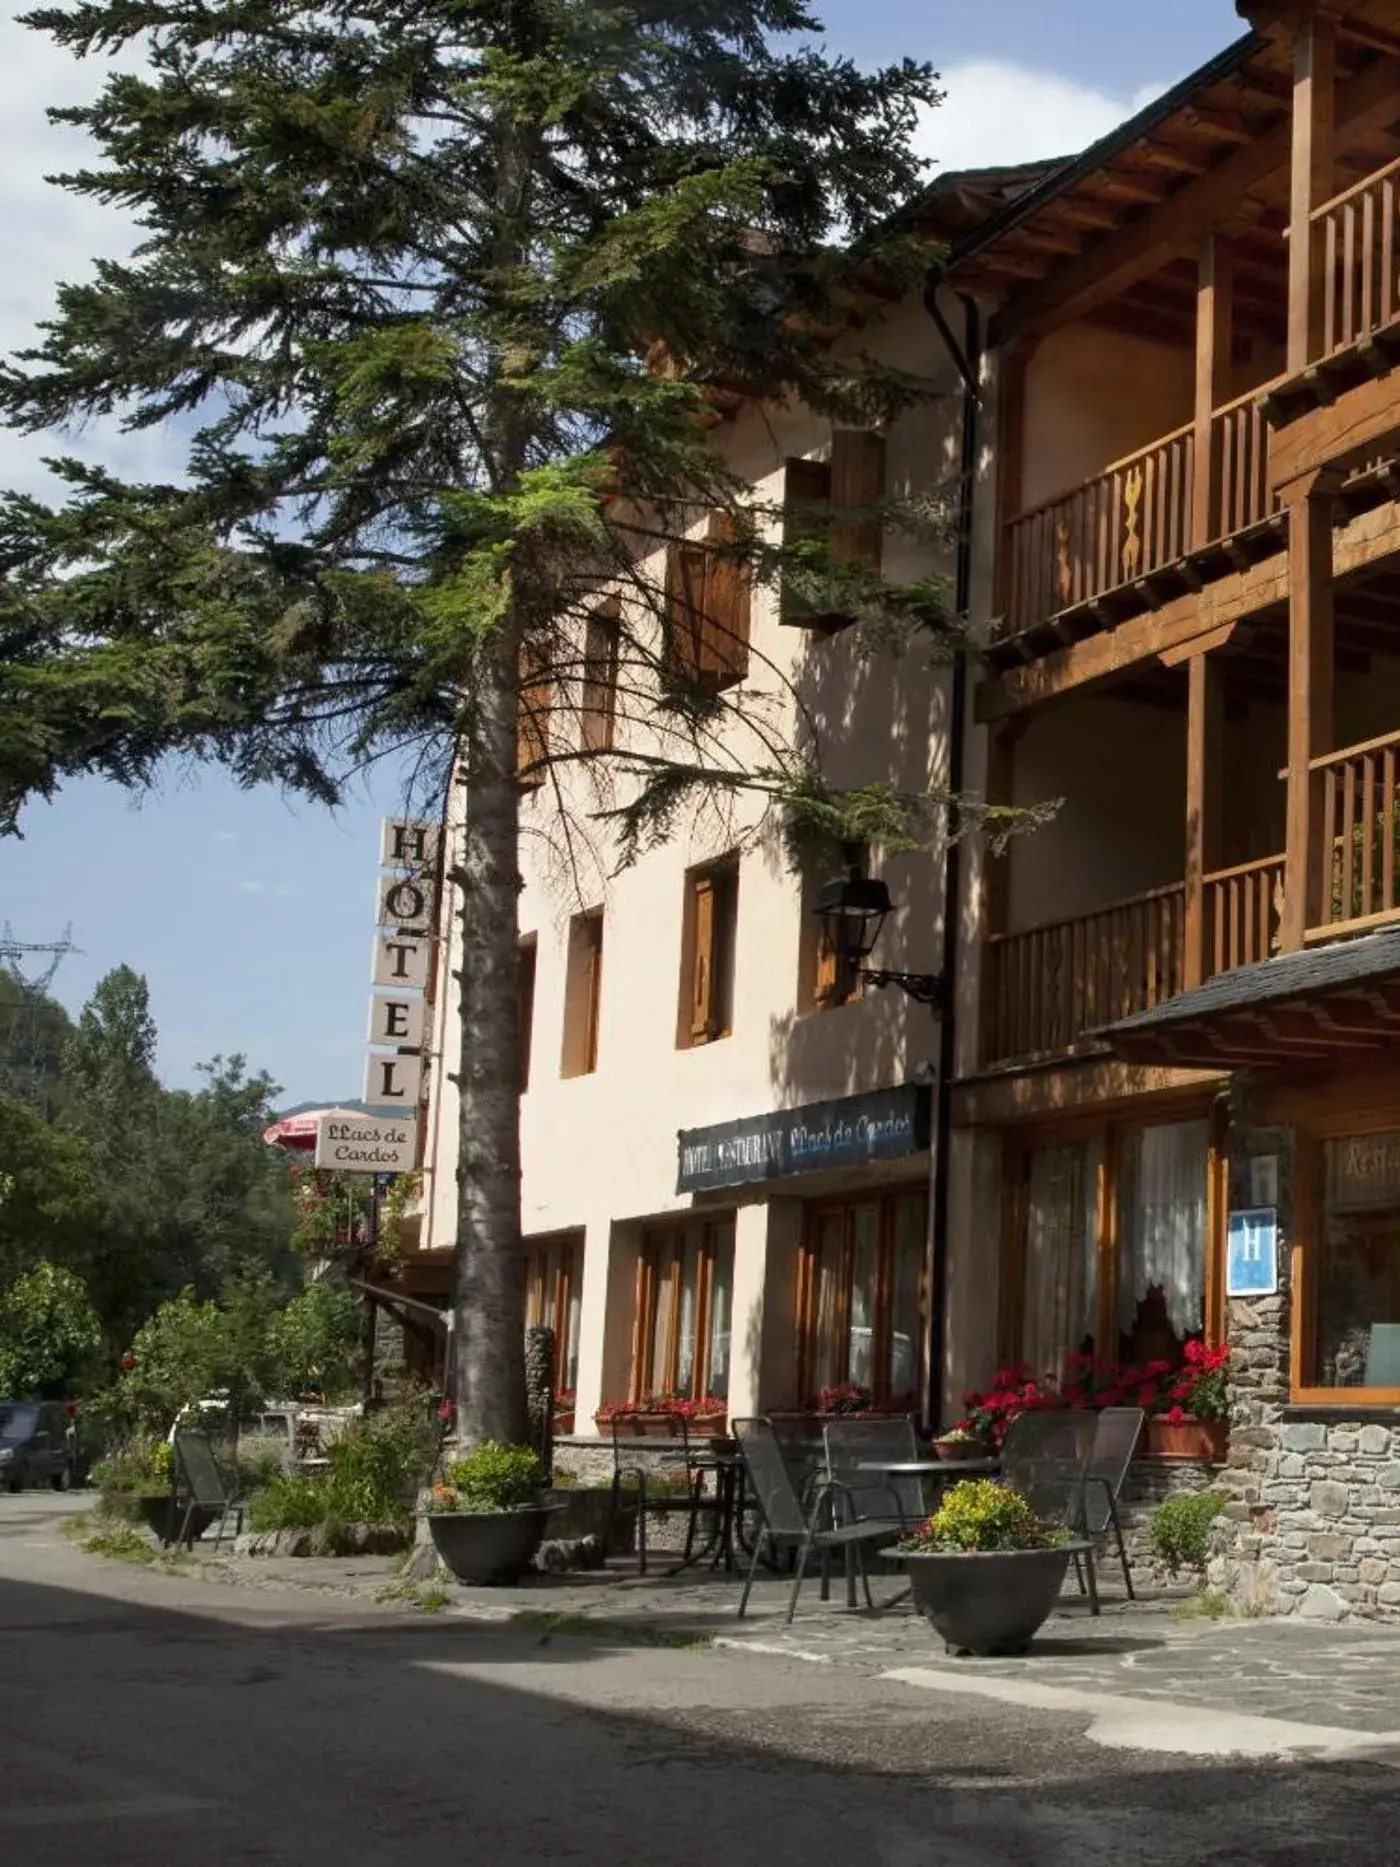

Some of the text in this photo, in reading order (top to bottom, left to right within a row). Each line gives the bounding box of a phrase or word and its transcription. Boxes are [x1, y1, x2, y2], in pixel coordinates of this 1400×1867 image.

[381, 824, 428, 1098] HOTEL
[384, 1128, 408, 1143] de
[833, 1120, 852, 1146] de
[335, 1145, 399, 1162] Cardos
[1243, 1217, 1261, 1261] H
